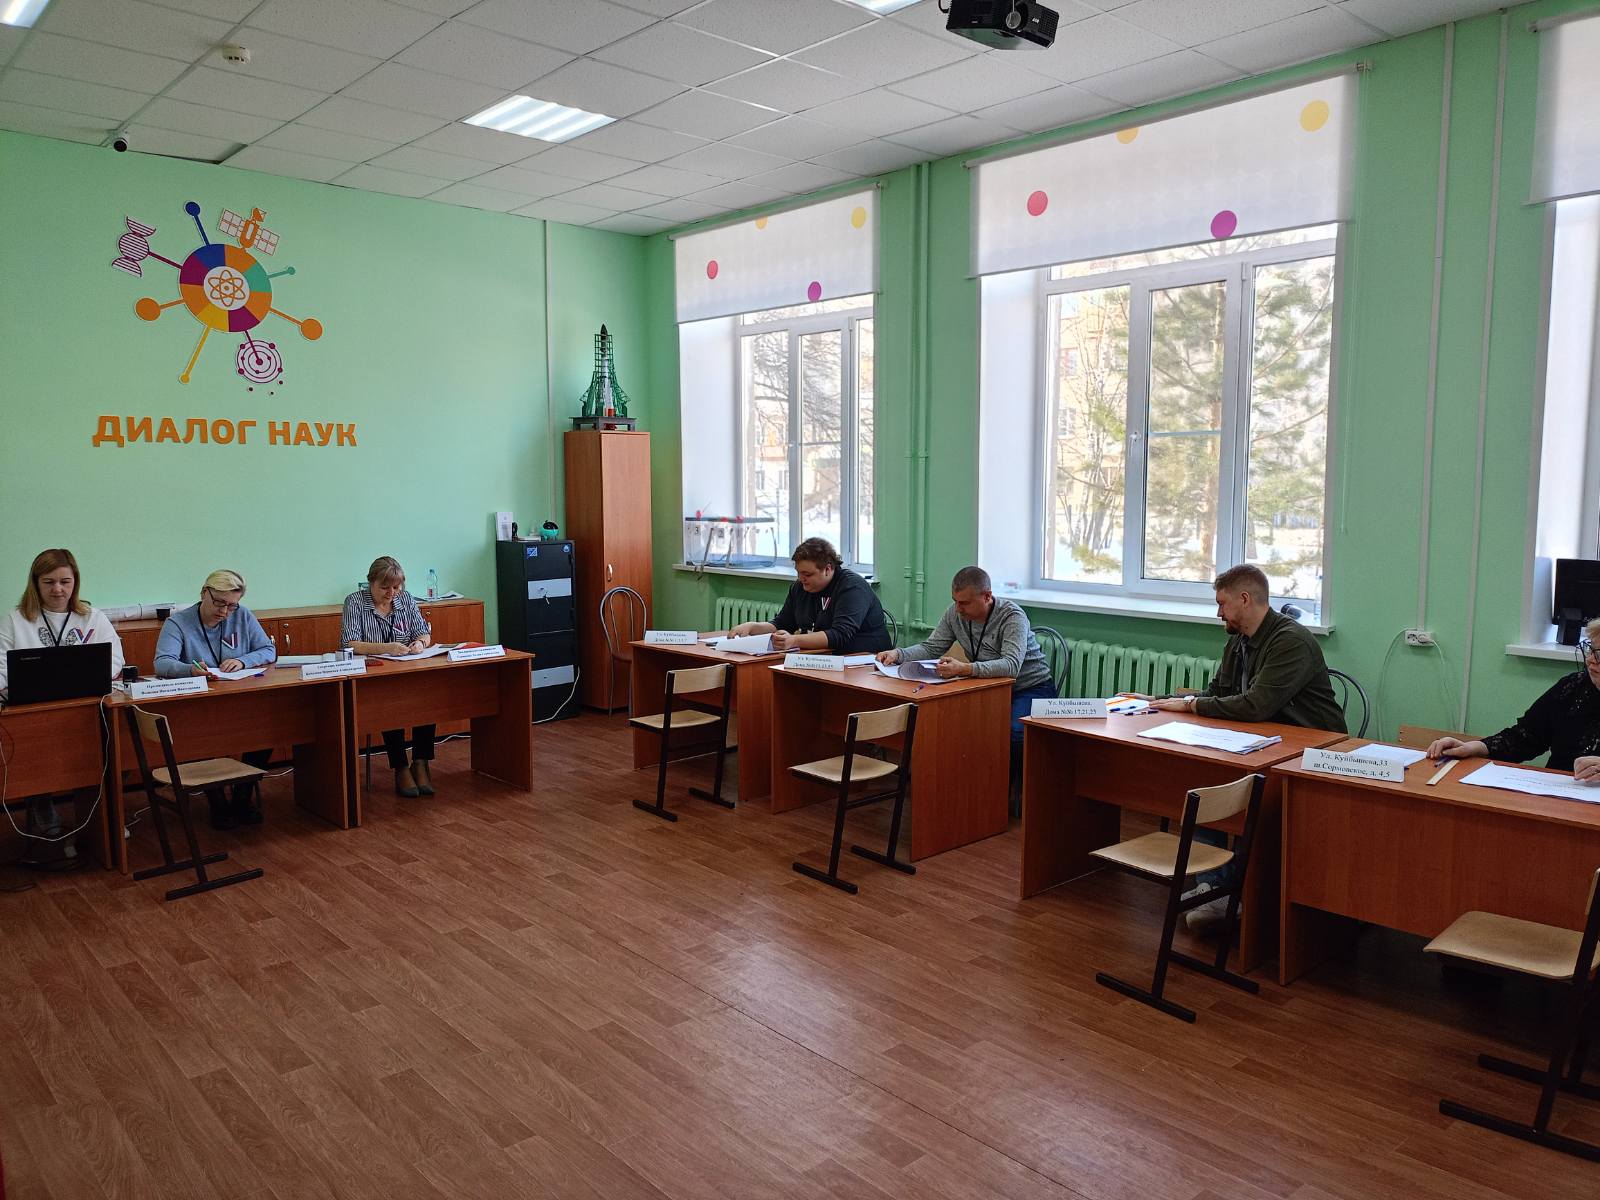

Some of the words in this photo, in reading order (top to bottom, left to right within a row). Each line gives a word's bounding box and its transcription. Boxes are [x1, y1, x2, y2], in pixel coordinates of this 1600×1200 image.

[92, 415, 257, 448] ДИАЛОГ
[268, 421, 358, 447] НАУК
[1320, 751, 1332, 760] Ул.
